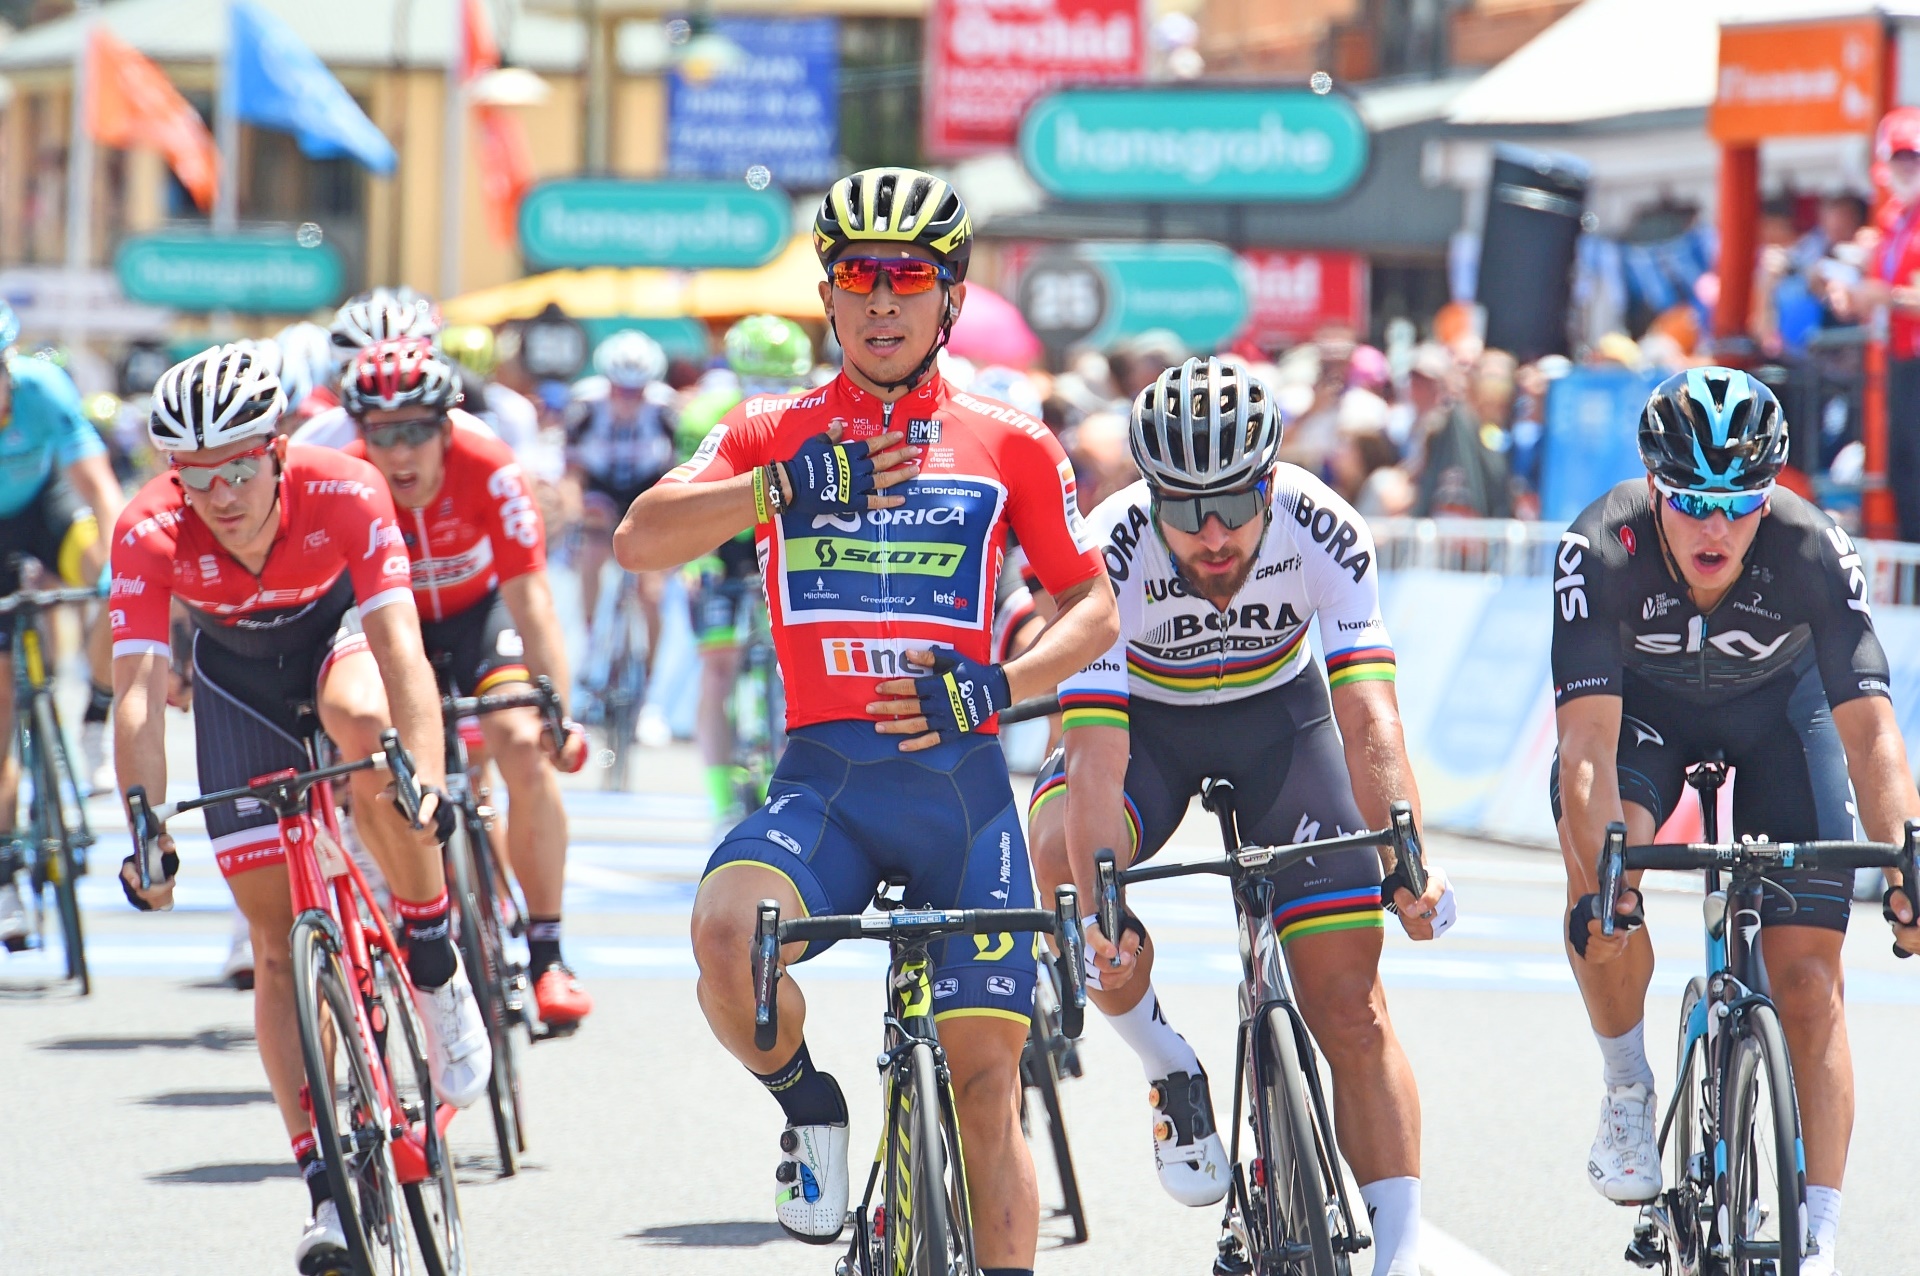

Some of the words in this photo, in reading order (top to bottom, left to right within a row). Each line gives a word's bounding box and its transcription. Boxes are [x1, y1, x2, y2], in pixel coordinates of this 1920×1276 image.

[1056, 110, 1332, 182] hansgrohe
[1031, 270, 1101, 331] 25
[746, 389, 828, 418] Santini
[909, 420, 940, 438] SMS
[823, 452, 834, 484] ORICA
[838, 456, 849, 499] SCOTT
[304, 480, 377, 501] TREK
[120, 508, 185, 546] TREK
[866, 506, 965, 526] ORICA
[1101, 503, 1149, 598] ORA
[1295, 492, 1371, 584] BORA
[841, 548, 958, 568] SCOTT
[1256, 556, 1295, 580] CRAFT
[803, 592, 840, 600] Mitchelton
[861, 595, 905, 604] GreenEDGE
[1150, 577, 1187, 602] UC
[109, 609, 126, 626] a
[1173, 603, 1304, 642] BORA
[1656, 608, 1668, 616] FOX
[1733, 601, 1782, 621] PINARELLO
[832, 641, 925, 674] iine
[1567, 677, 1609, 691] DANNY
[950, 690, 967, 729] SCOTT
[967, 698, 979, 726] ORICA
[1000, 831, 1011, 884] Mitchelton
[897, 916, 918, 924] SRM
